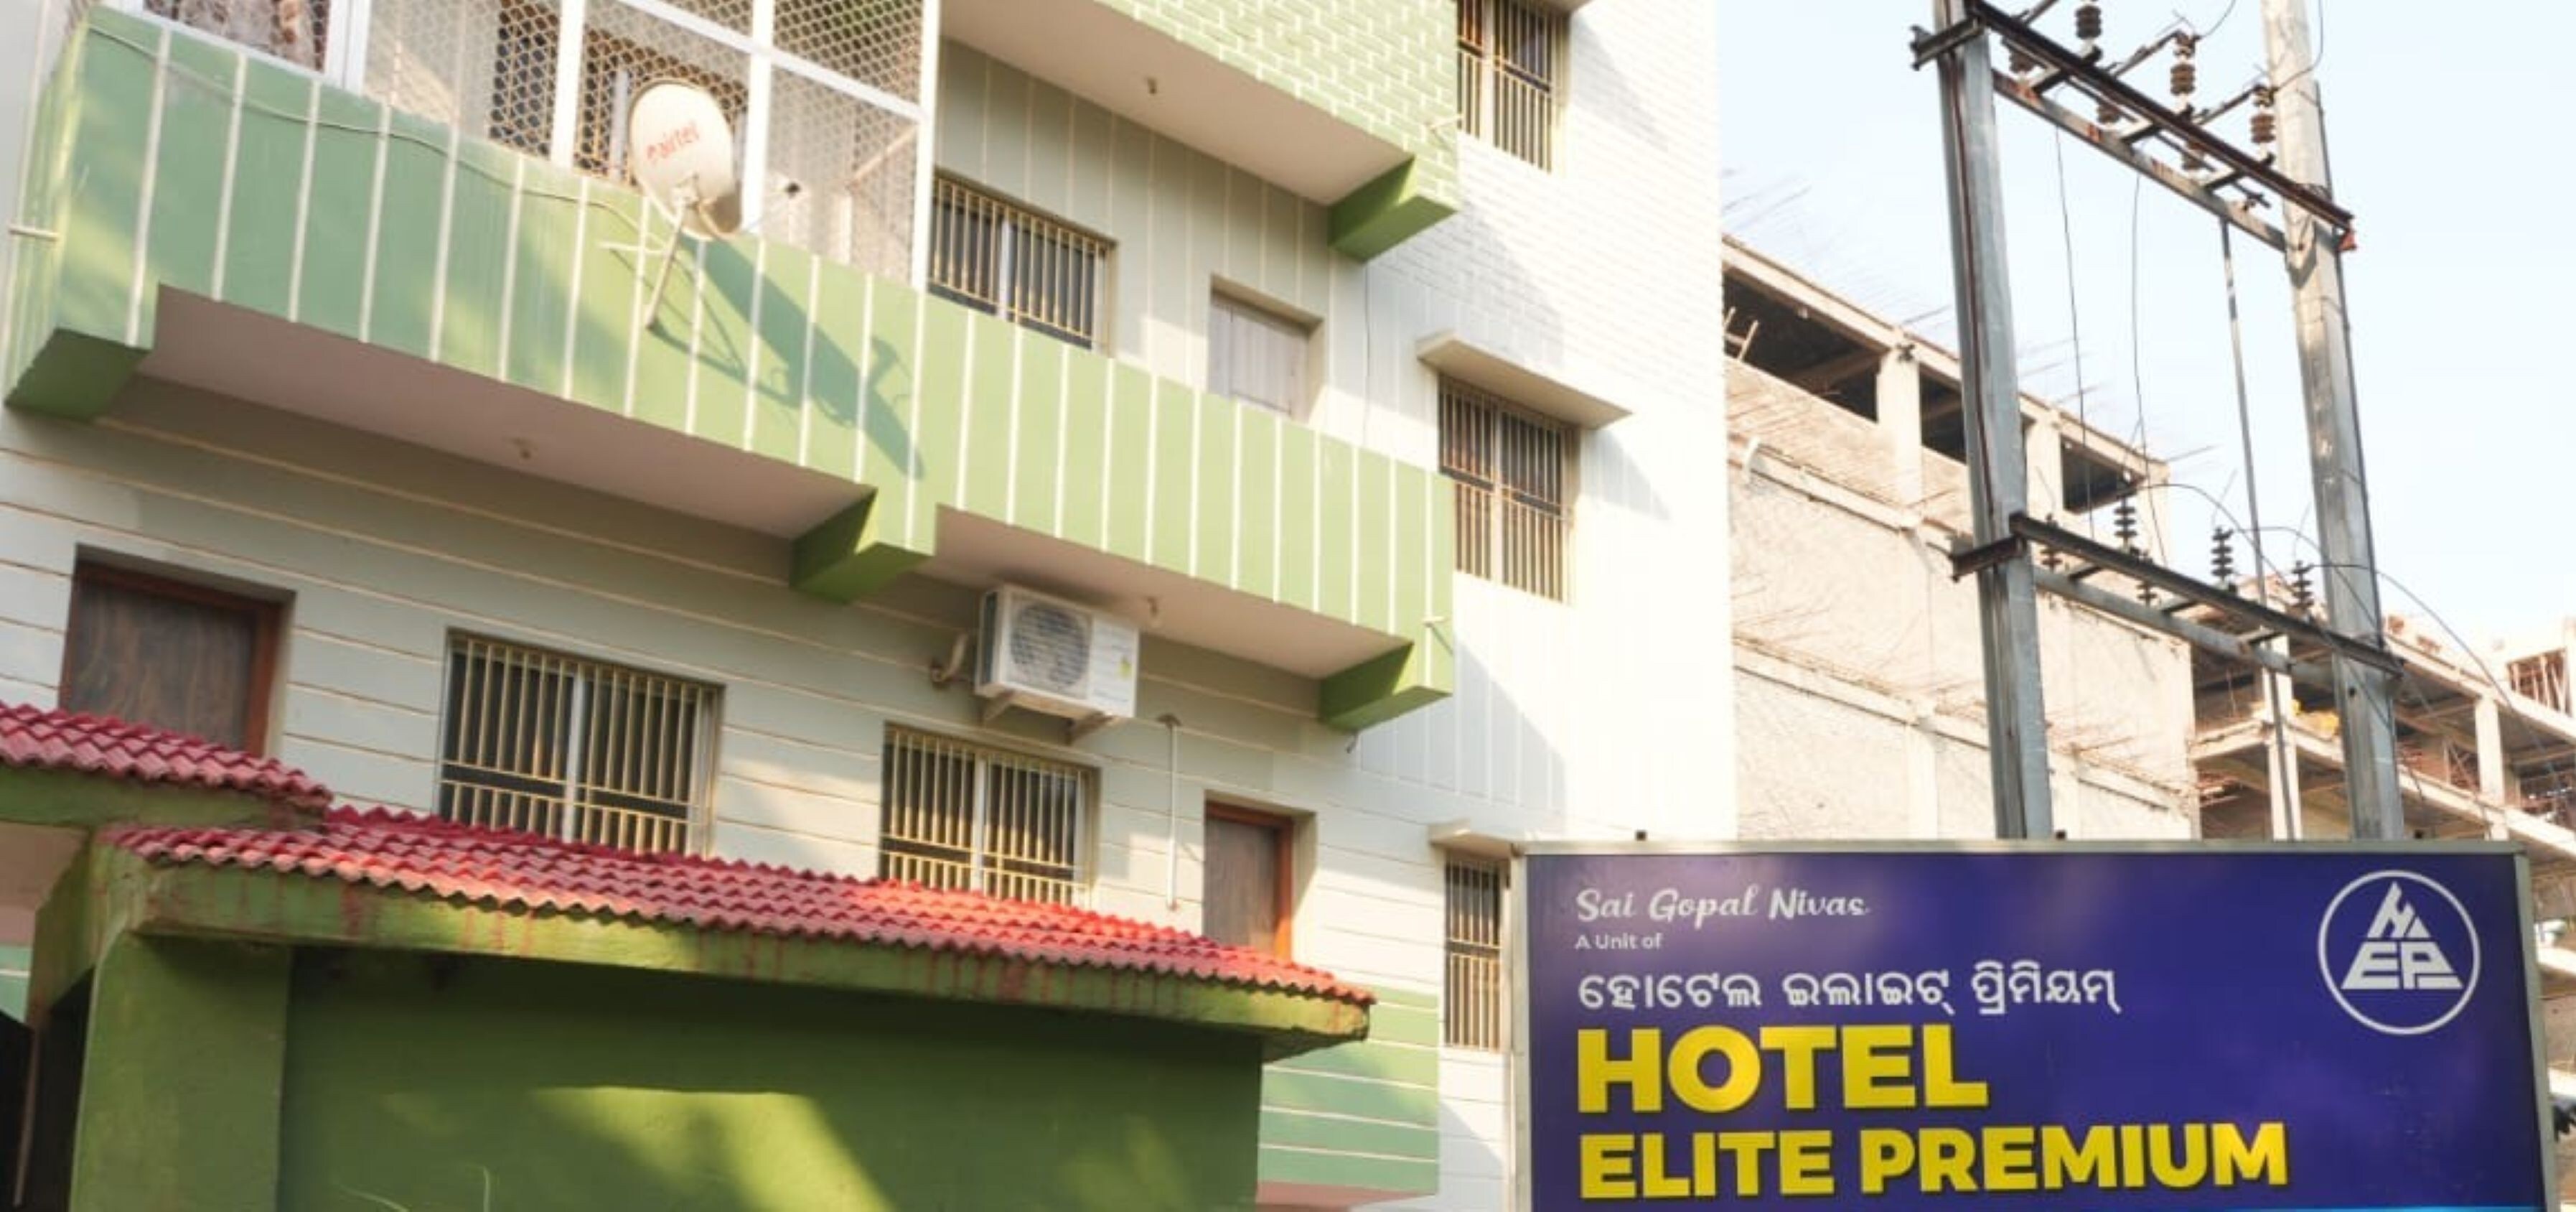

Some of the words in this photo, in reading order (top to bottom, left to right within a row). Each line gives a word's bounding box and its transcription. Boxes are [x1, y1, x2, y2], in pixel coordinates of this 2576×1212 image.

[1576, 889, 1636, 922] Sai
[1649, 884, 1758, 929] Gopal
[1575, 935, 1591, 950] A
[1595, 933, 1637, 949] Unit
[1641, 933, 1663, 949] of
[1578, 972, 1762, 1010] ହୋଟେଲ
[1577, 1024, 1990, 1114] HOTEL
[1579, 1129, 1835, 1201] ELITE
[1859, 1122, 2289, 1194] PREMIUM
